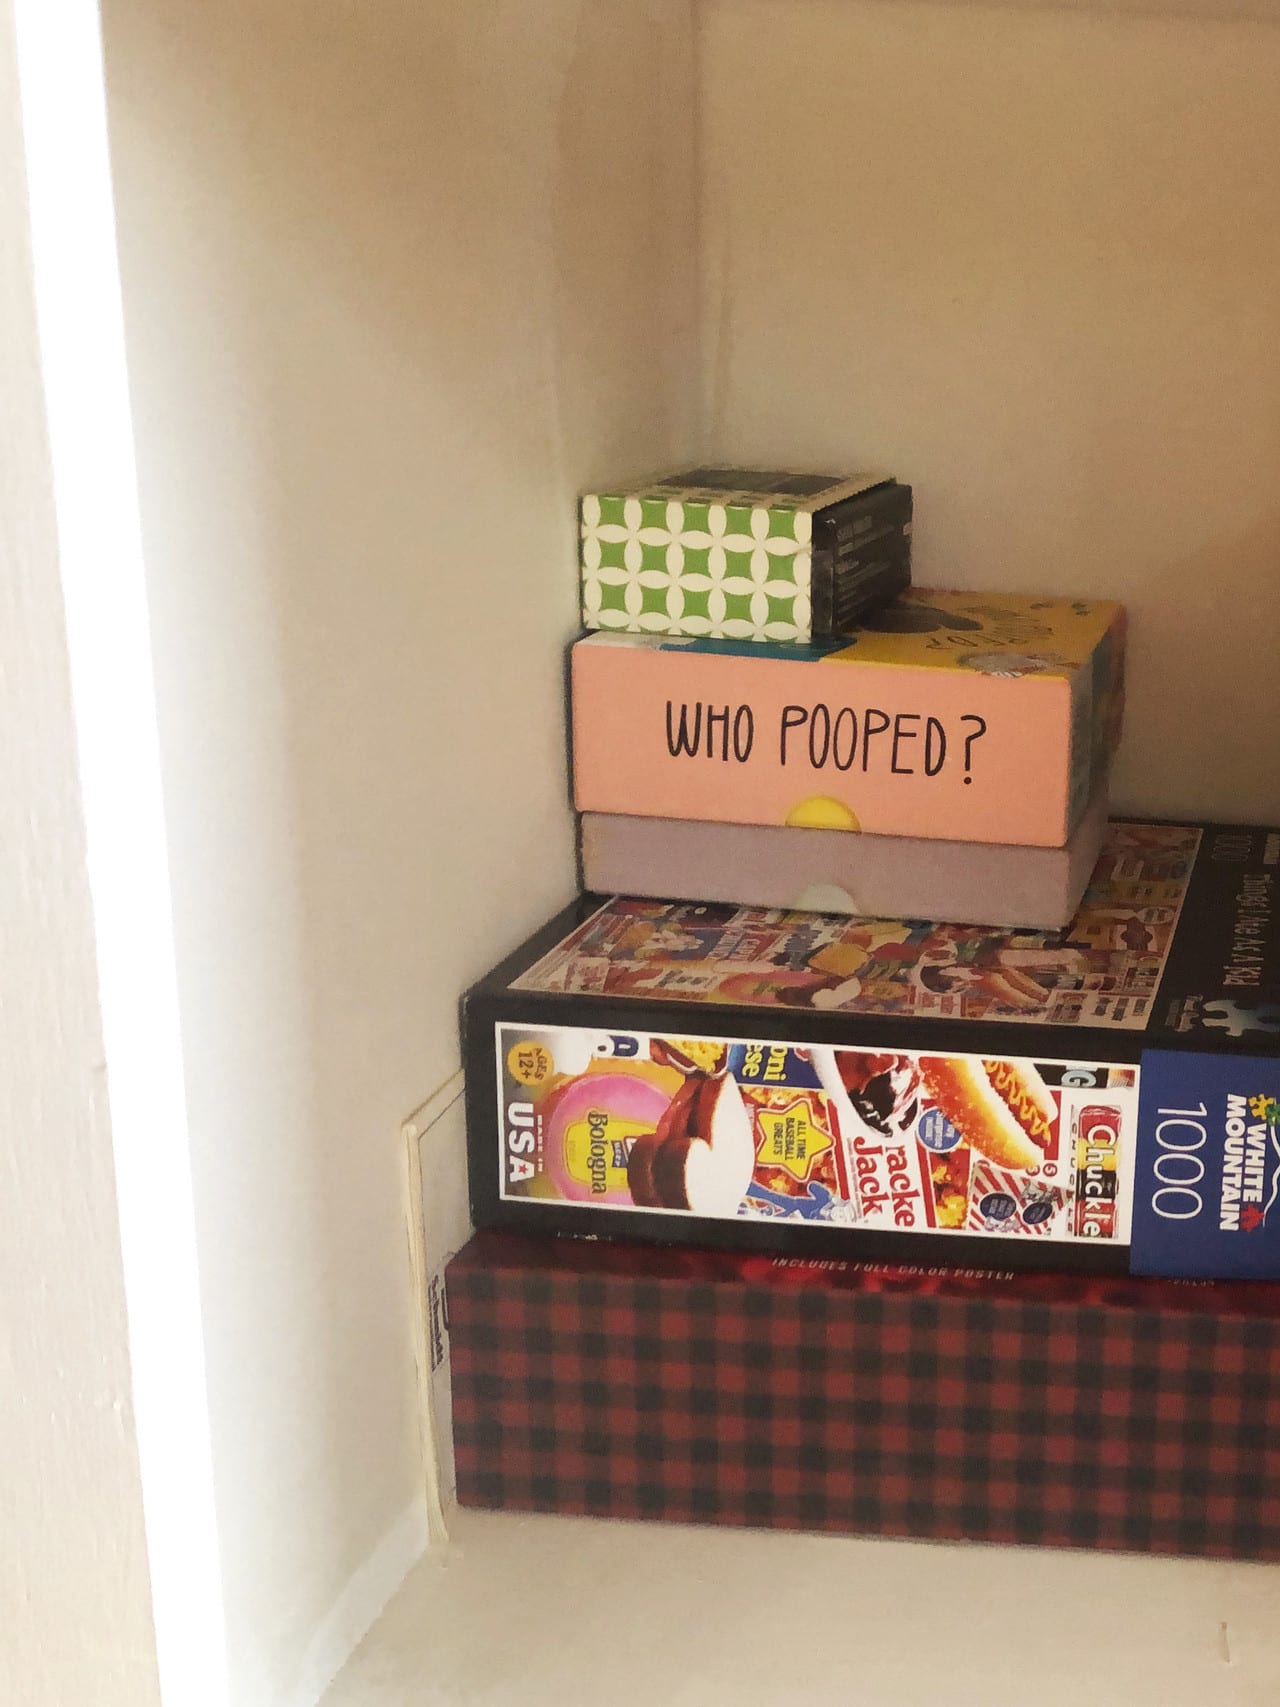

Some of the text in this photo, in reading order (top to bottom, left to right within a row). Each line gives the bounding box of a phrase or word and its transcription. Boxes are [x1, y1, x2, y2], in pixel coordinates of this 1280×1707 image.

[665, 700, 987, 785] WHO POOPED?
[517, 1050, 534, 1079] 12+
[533, 1047, 547, 1081] AGES
[508, 1102, 535, 1183] USA
[586, 1111, 609, 1194] Bologna
[773, 1122, 784, 1155] GREATS
[784, 1117, 796, 1161] BASEBALL
[796, 1120, 807, 1160] ALL TIME
[853, 1136, 889, 1217] Jack
[1152, 1102, 1208, 1219] 1000
[1219, 1094, 1247, 1232] MOUNTAIN
[1241, 1122, 1268, 1204] WHITE
[1083, 1124, 1116, 1237] Chuckle
[771, 1257, 1015, 1280] INCLUDES FULL COLOR POSTER
